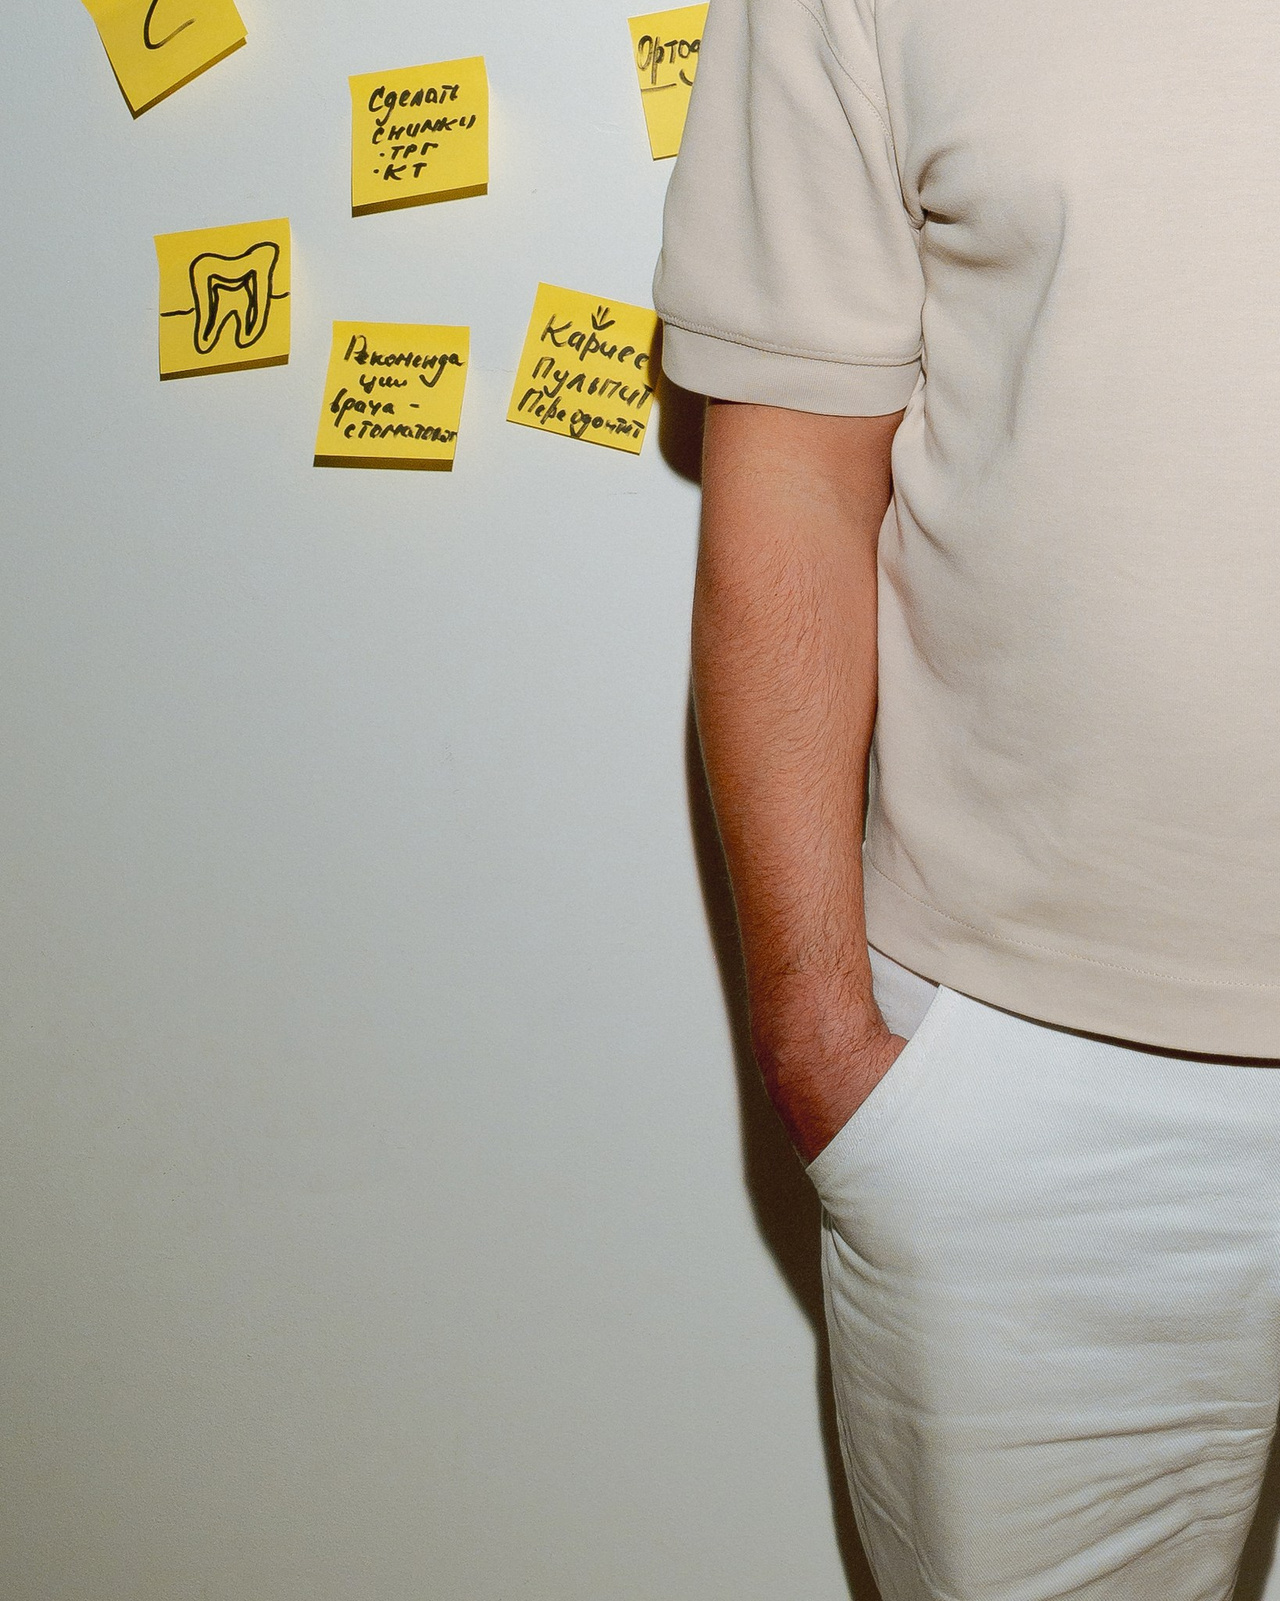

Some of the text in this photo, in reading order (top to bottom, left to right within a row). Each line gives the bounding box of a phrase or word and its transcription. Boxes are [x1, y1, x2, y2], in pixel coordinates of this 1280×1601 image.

[368, 84, 460, 126] Сделать
[540, 314, 649, 370] Кариес
[532, 356, 654, 410] Пульпит
